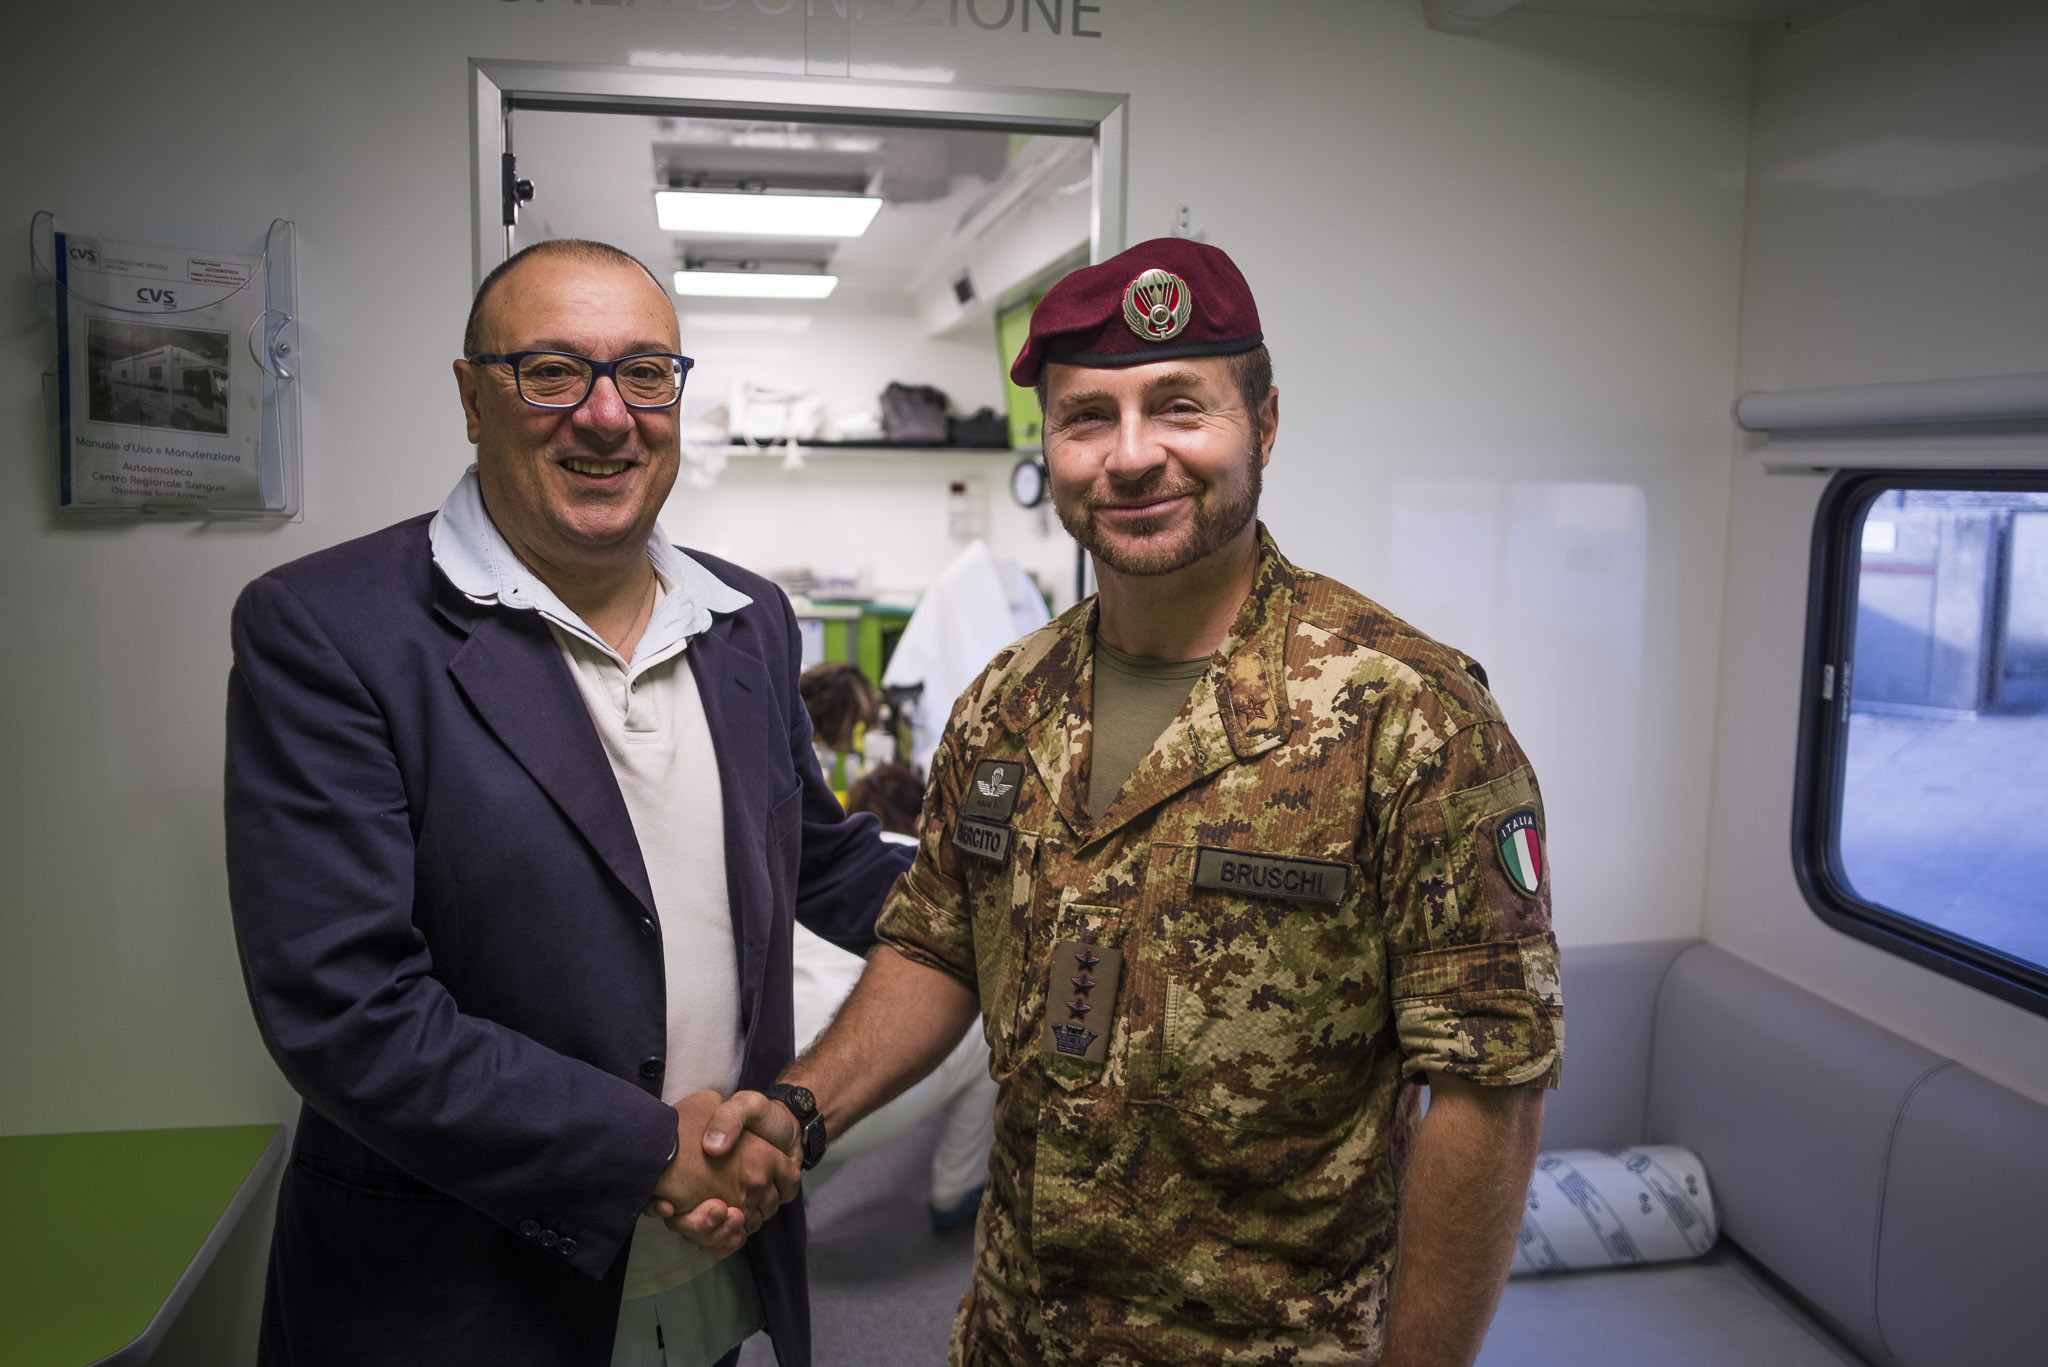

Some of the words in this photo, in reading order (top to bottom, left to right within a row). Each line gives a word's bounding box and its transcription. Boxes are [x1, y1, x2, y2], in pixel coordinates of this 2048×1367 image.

[69, 248, 96, 260] CVS
[136, 288, 175, 304] CVS
[76, 437, 121, 450] Manuale
[123, 443, 153, 454] d'Uso
[155, 447, 162, 455] e
[165, 447, 241, 463] Manutenzione
[122, 462, 193, 477] Autoemoteca
[92, 472, 127, 484] Centro
[130, 476, 182, 489] Regionale
[184, 480, 226, 493] Sangue
[111, 486, 153, 497] Ospedale
[1501, 816, 1533, 838] ITALIA
[1220, 861, 1324, 894] BRUSCHI
